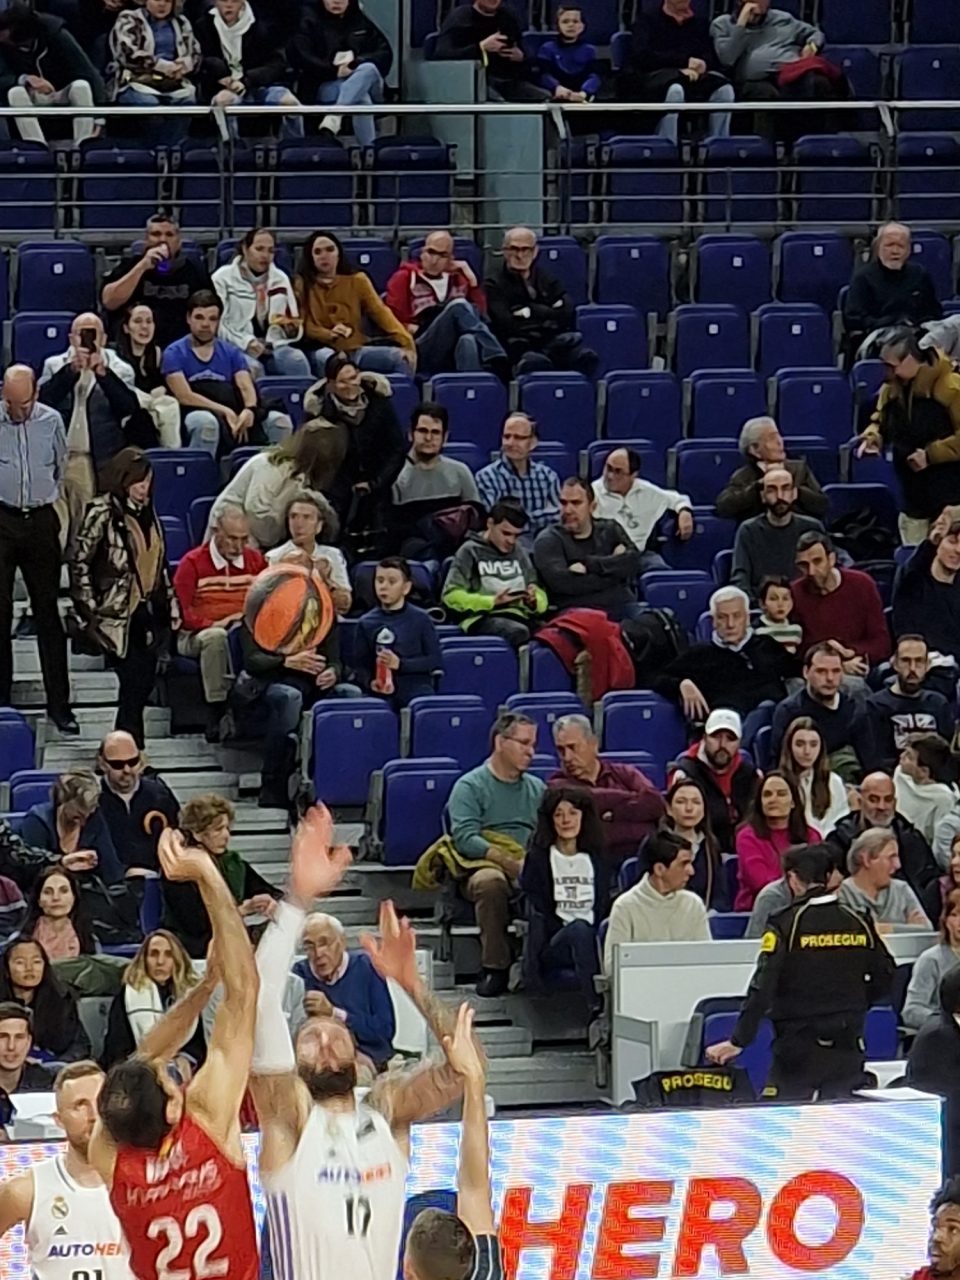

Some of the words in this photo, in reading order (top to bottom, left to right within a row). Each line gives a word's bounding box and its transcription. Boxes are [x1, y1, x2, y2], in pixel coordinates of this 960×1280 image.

[478, 560, 523, 576] NASA
[800, 933, 867, 949] PROSEGUR
[661, 1071, 732, 1092] PROSEGU
[47, 1243, 123, 1258] AUTOHE
